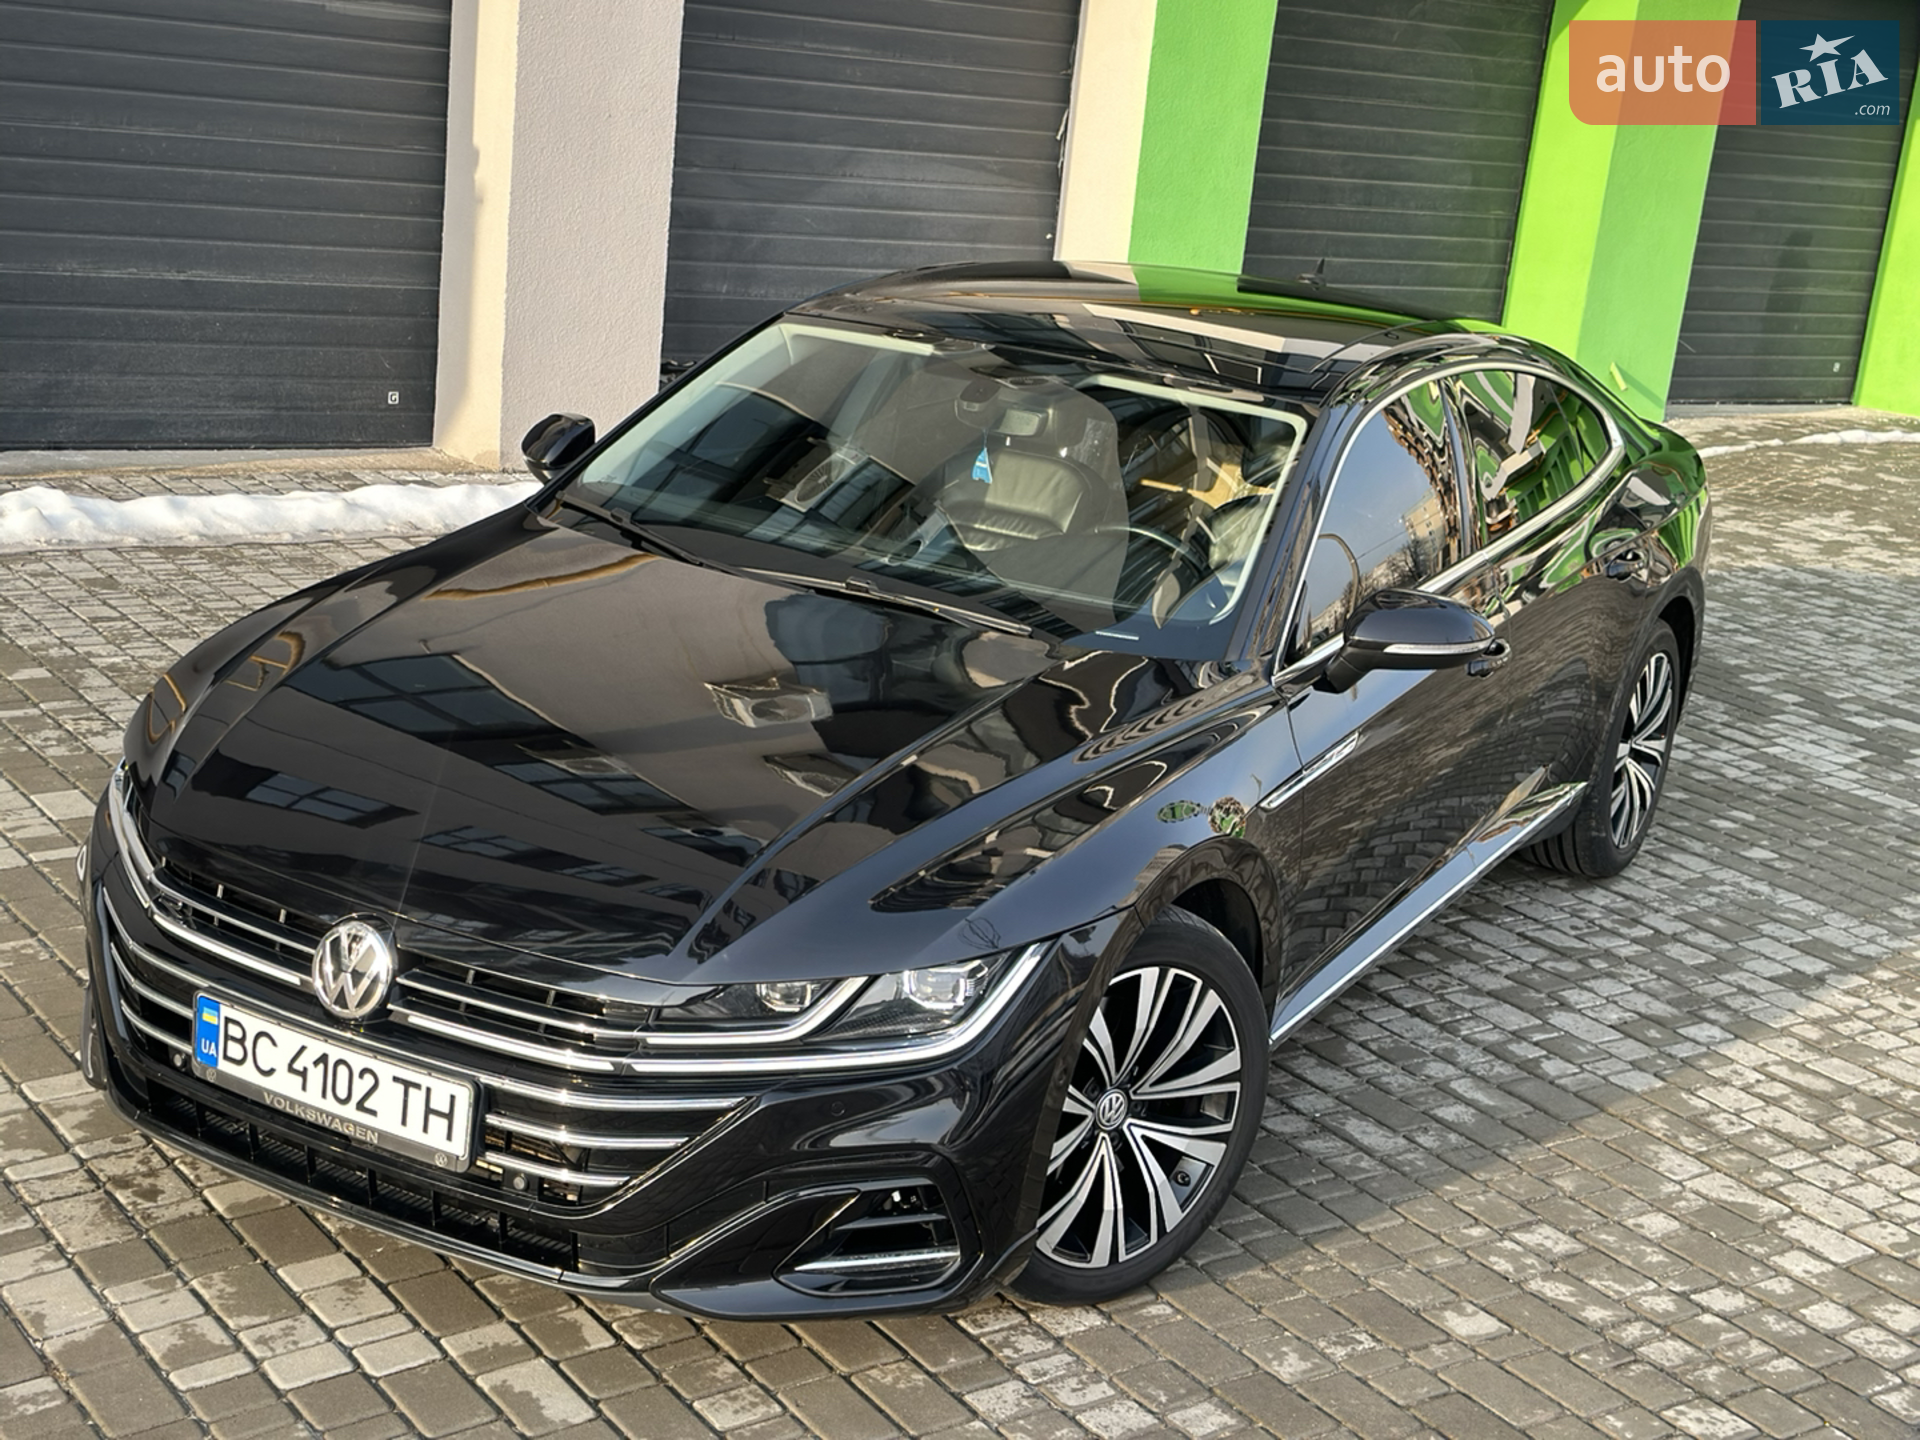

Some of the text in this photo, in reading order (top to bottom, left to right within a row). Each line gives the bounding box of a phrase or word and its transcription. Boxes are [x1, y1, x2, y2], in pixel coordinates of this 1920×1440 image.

[201, 1037, 217, 1058] UA
[223, 1016, 456, 1143] BC 4102 TH
[264, 1092, 378, 1144] VOLKSWAGEN
